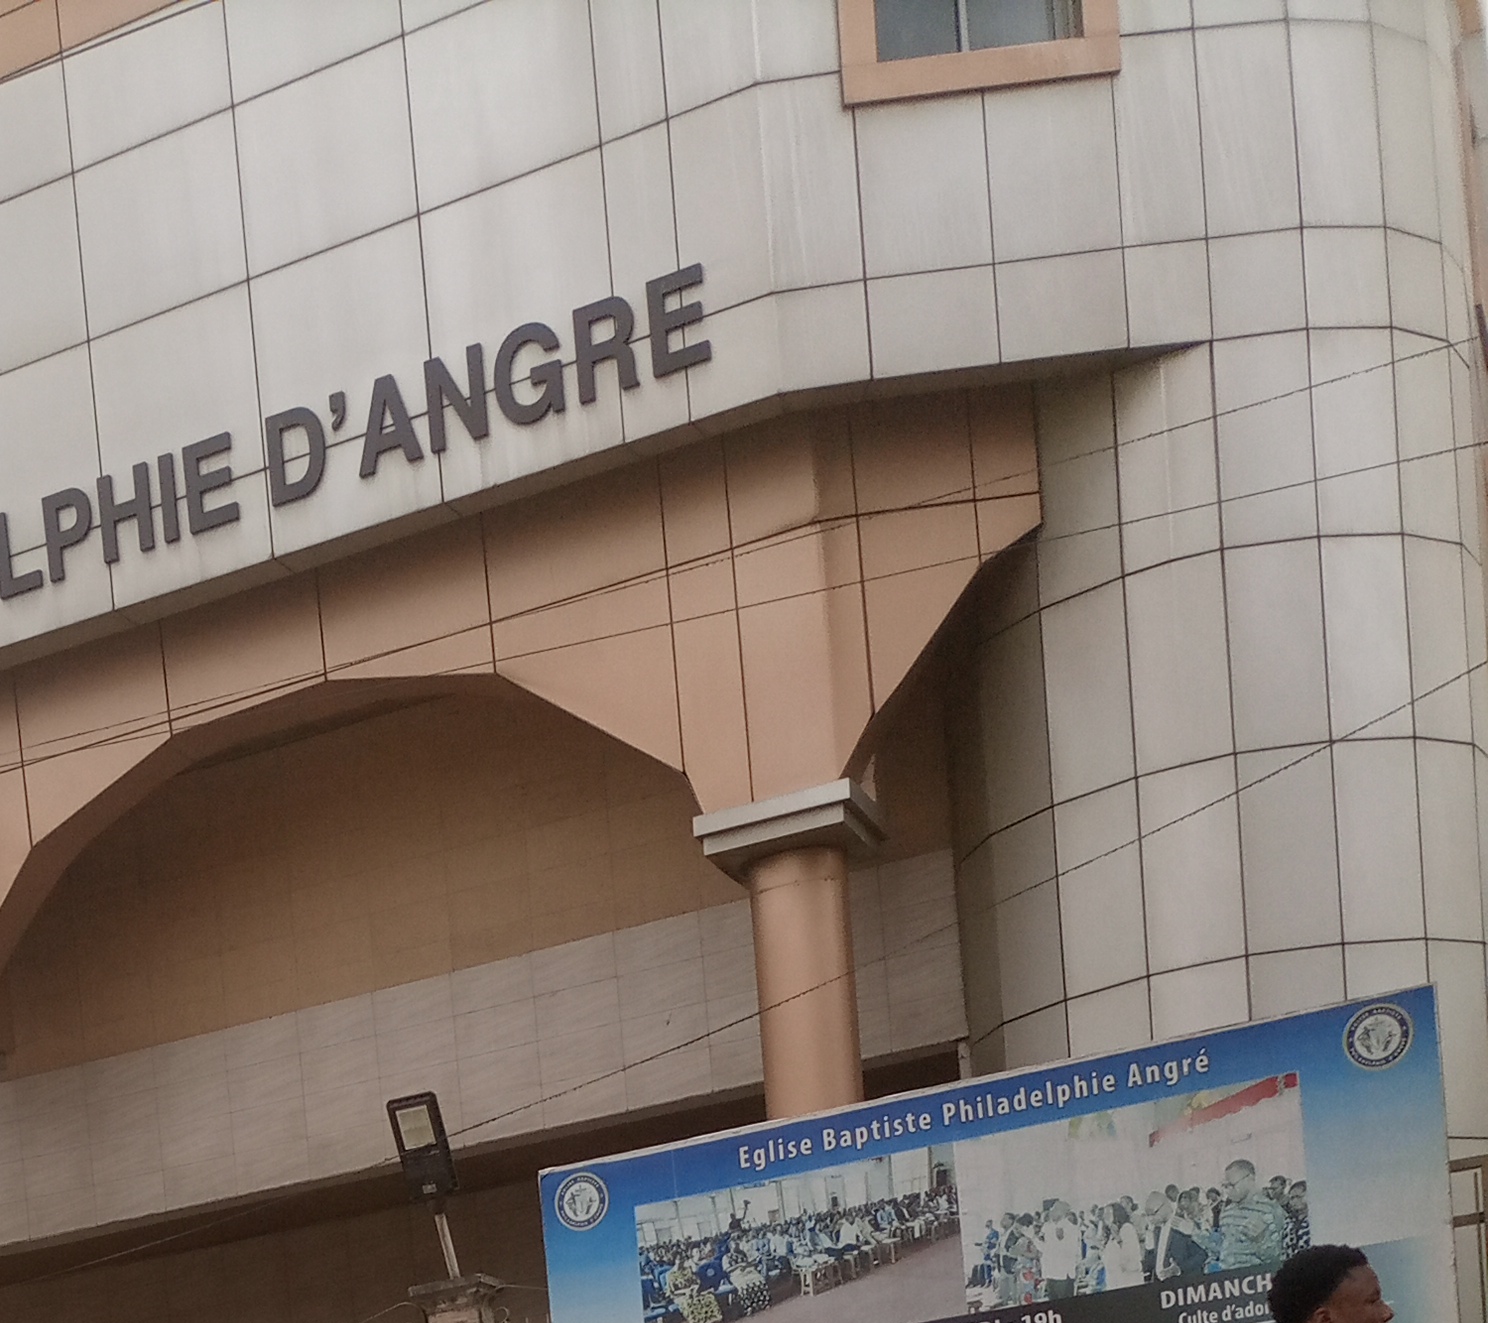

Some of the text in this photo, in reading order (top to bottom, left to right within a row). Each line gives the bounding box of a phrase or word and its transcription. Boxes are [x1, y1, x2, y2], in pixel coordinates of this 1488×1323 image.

[265, 262, 713, 508] D'ANGRE
[738, 1048, 1210, 1171] Eglise Baptiste Philadelphie Angré
[1160, 1273, 1274, 1309] DIMANCH
